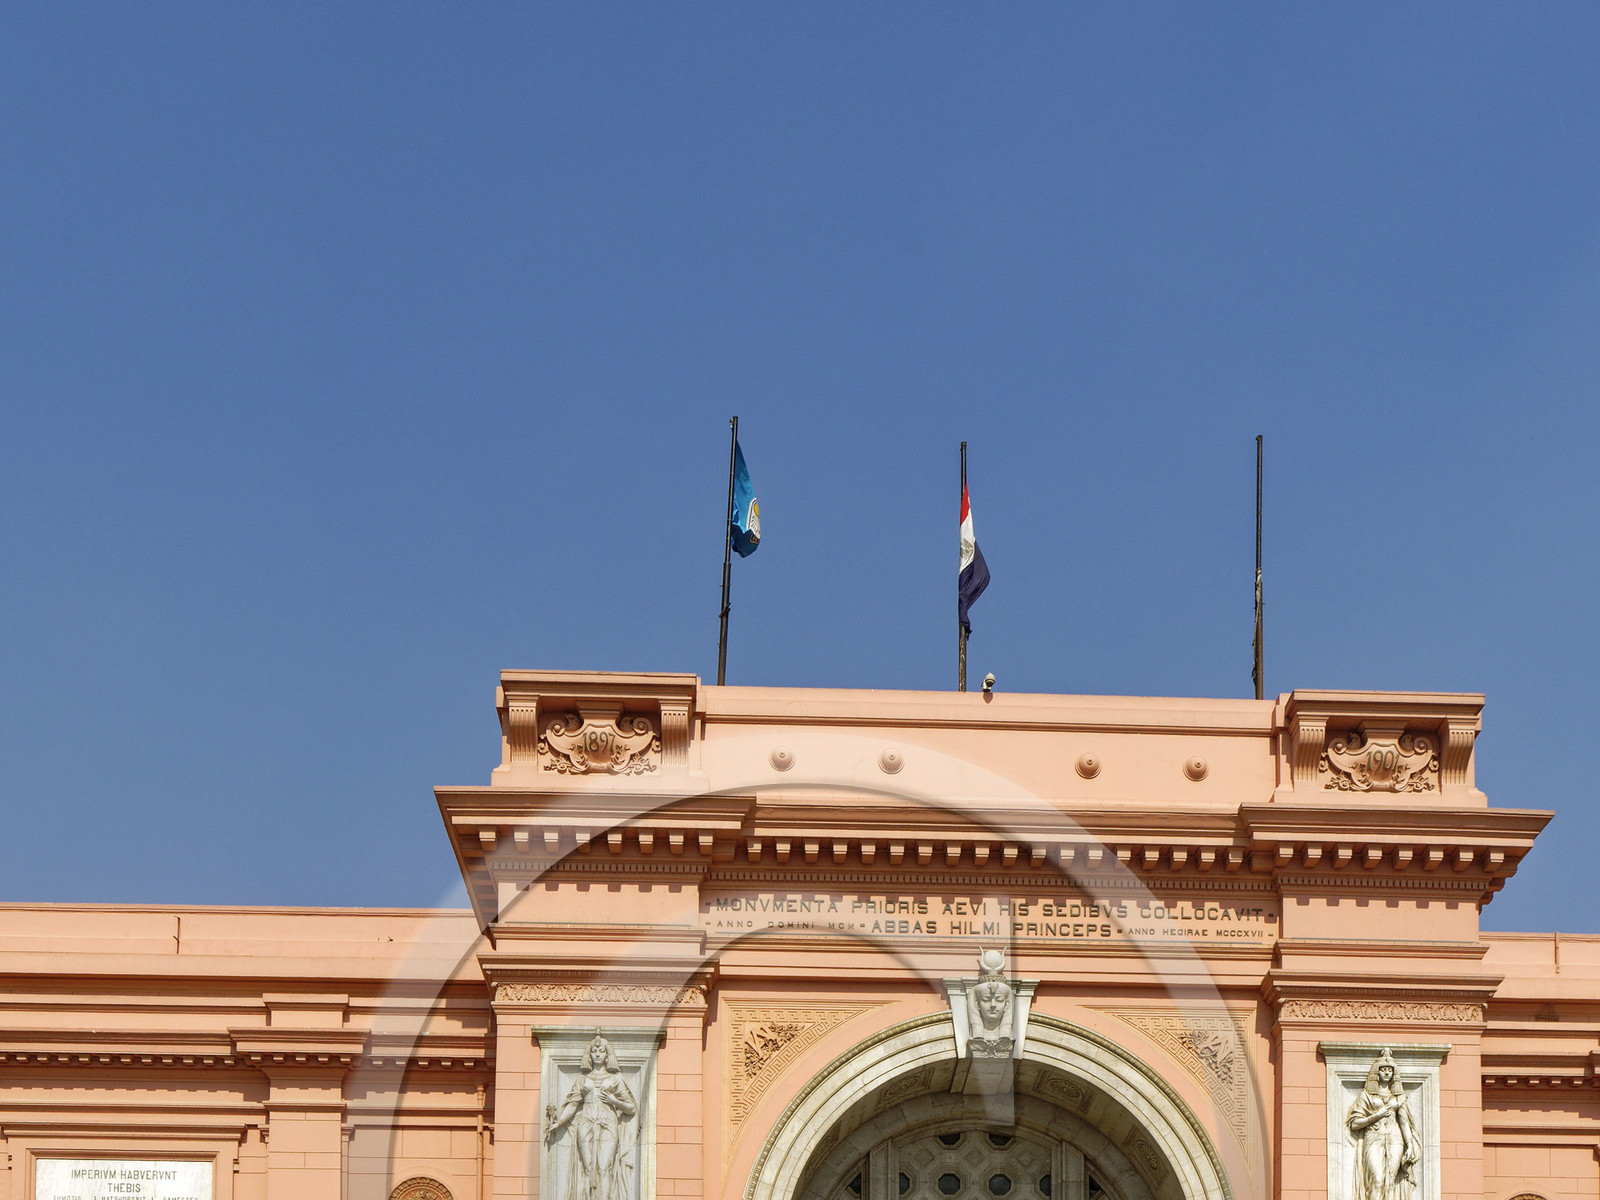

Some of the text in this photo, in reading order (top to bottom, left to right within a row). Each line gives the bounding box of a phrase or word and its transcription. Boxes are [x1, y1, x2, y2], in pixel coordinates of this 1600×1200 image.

[582, 730, 616, 753] 1897
[1366, 749, 1400, 773] 1901
[716, 897, 1264, 922] MONVMENTA PRIORIS AEVI HIS SEDIBVS COLLOCAVIT
[716, 920, 753, 928] ANNO
[767, 921, 815, 929] DOMINI
[828, 922, 855, 930] MCM
[871, 920, 937, 934] ABBAS
[950, 920, 1000, 935] HILMI
[1012, 921, 1112, 937] PRINCEPS
[1128, 928, 1156, 936] ANNO
[1162, 928, 1209, 936] HEGIRAE
[71, 1168, 178, 1181] IMPERIVM HABVERVNT
[107, 1182, 141, 1193] THEBIS
